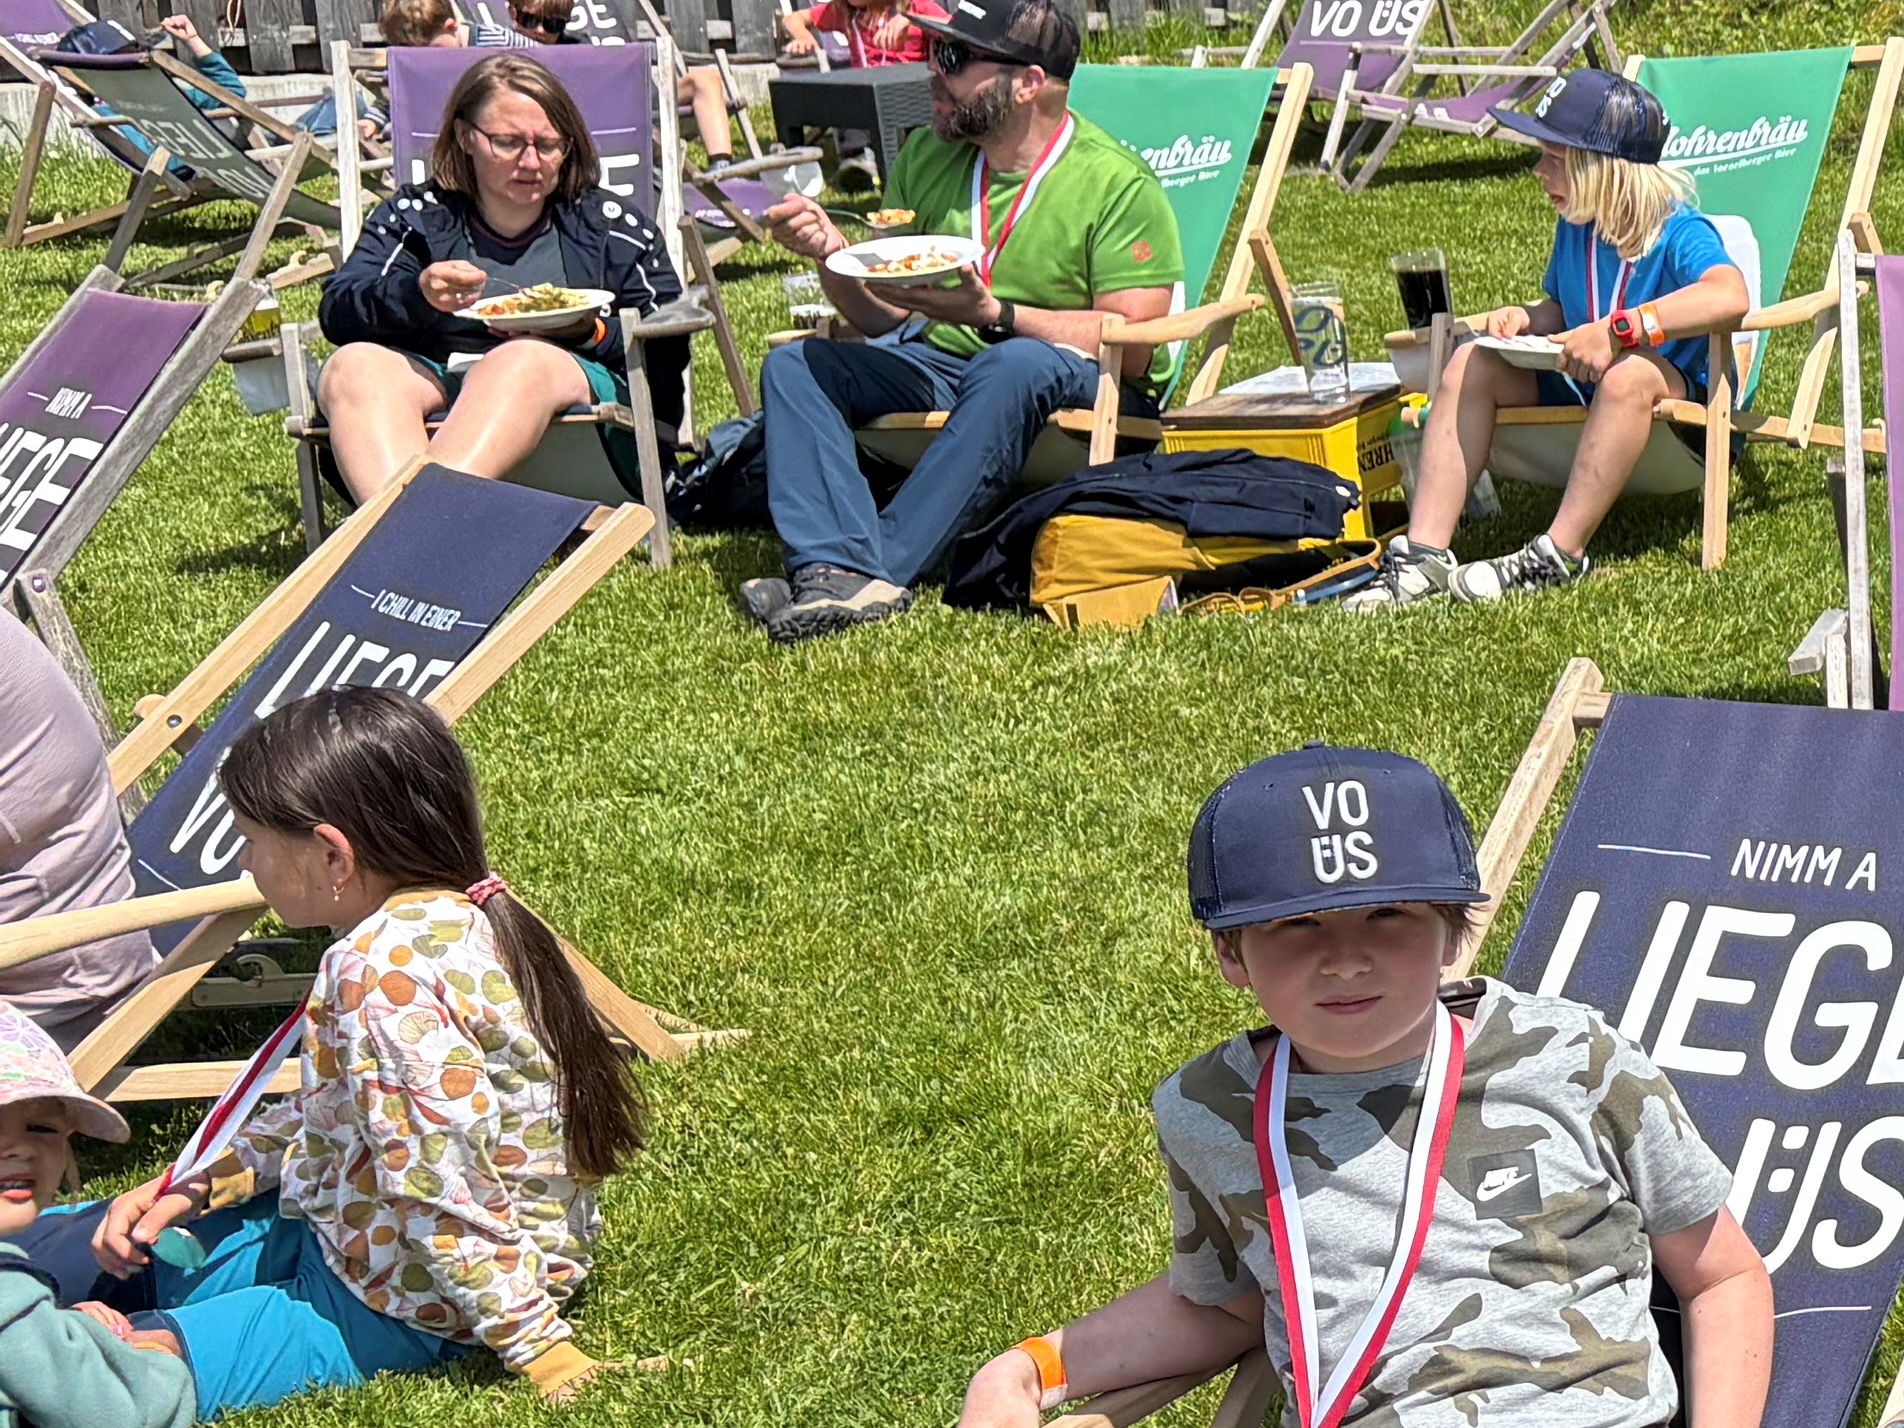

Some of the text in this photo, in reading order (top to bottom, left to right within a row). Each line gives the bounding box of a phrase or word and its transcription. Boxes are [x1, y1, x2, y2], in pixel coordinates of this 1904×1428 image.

[1310, 0, 1362, 37] VO
[378, 592, 415, 620] CHILL
[407, 601, 430, 624] IN
[421, 605, 461, 632] EINER
[1302, 780, 1369, 830] VO
[1311, 831, 1378, 883] ÜS
[1730, 838, 1877, 892] NIMM A
